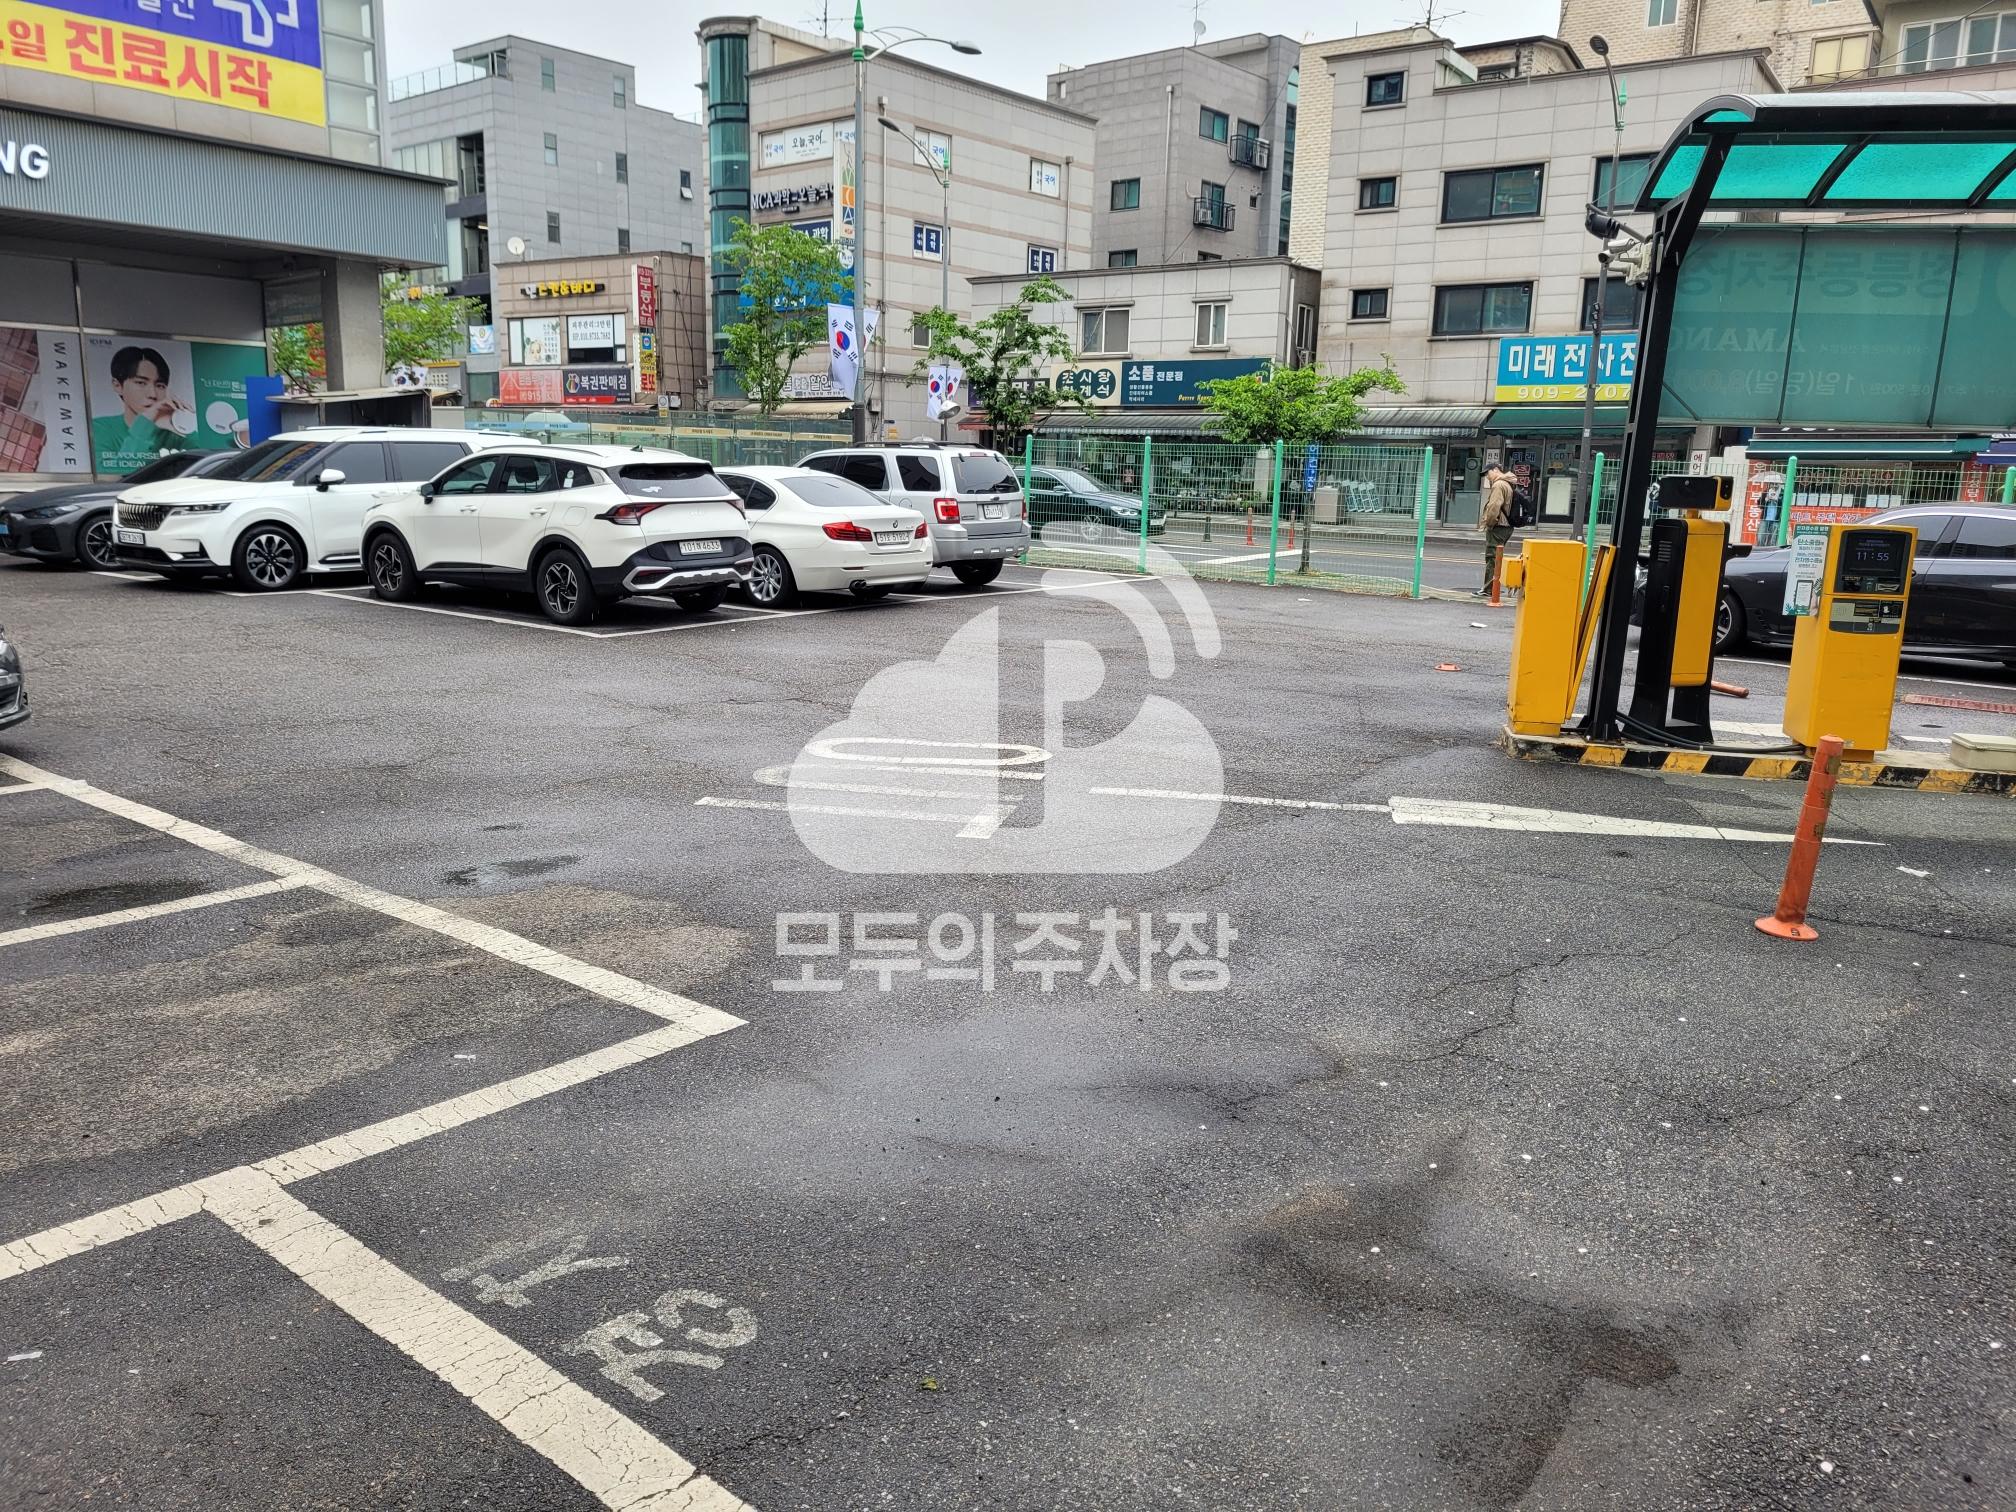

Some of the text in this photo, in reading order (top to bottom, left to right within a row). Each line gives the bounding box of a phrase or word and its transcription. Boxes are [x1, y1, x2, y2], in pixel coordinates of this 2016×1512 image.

[64, 19, 273, 109] 진료시작
[640, 276, 652, 316] 부동산
[1128, 365, 1184, 382] 소품 전문점
[1508, 344, 1556, 379] 미래
[581, 374, 627, 390] 복권판매점
[53, 341, 77, 466] WAKEMAKE
